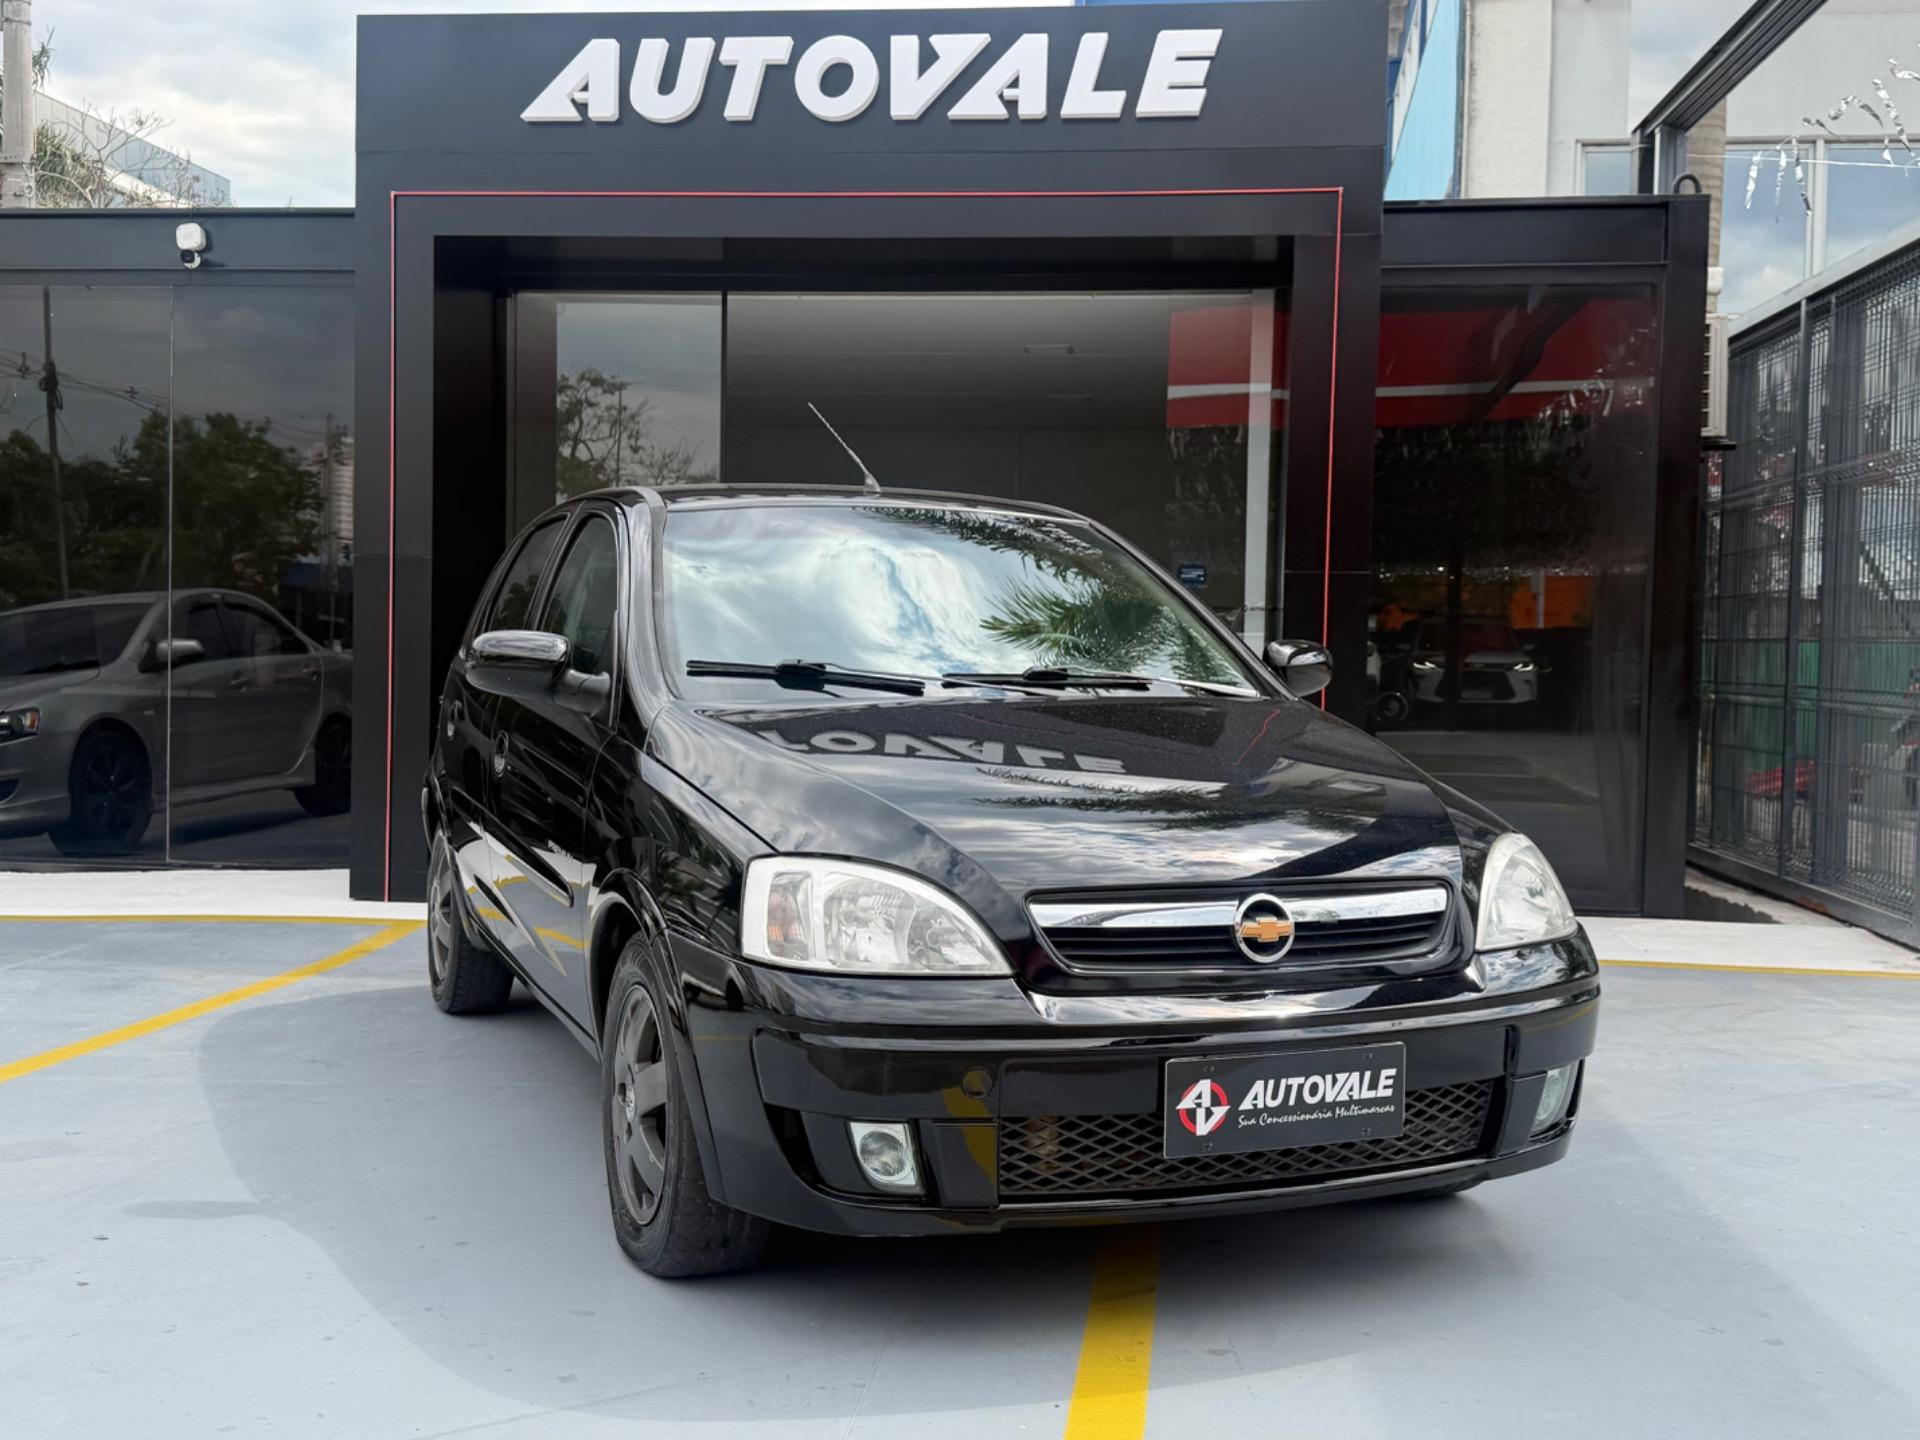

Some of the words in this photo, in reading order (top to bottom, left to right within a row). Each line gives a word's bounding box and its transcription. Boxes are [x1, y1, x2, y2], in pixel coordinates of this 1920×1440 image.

[519, 28, 1223, 123] AUTOVALE
[1238, 1068, 1397, 1110] AUTOVALE
[1238, 1114, 1257, 1128] Sua
[1335, 1104, 1395, 1119] Multimarcas
